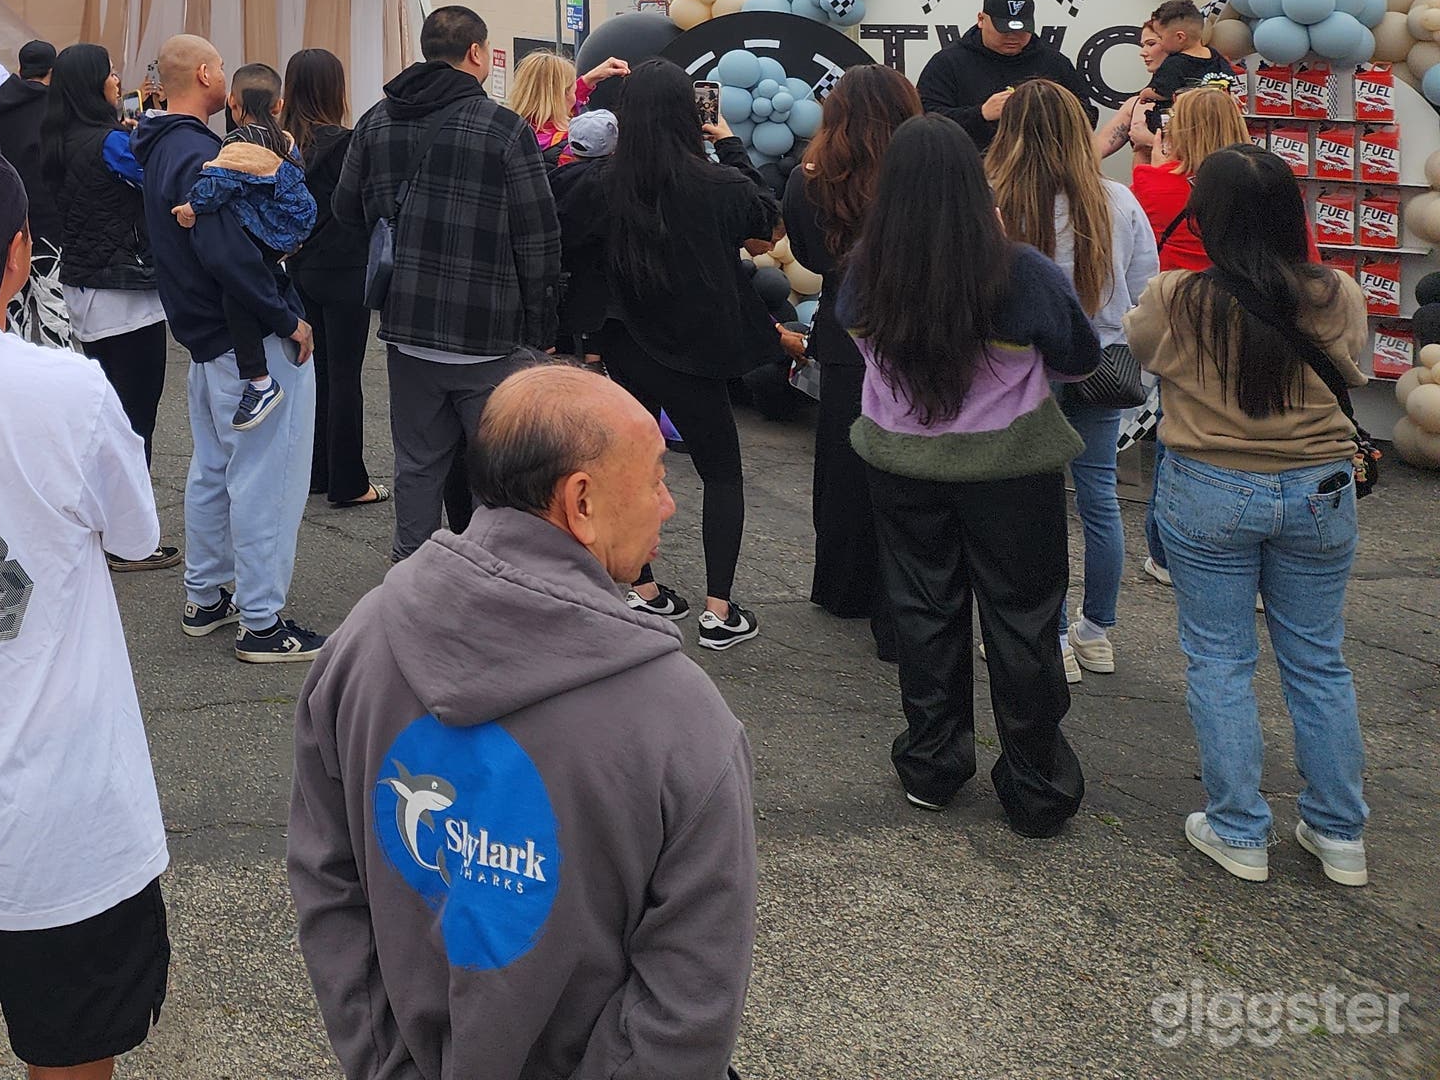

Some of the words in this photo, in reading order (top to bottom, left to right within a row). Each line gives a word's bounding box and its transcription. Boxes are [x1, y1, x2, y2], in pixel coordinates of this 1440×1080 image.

[860, 24, 1148, 110] TO
[1258, 76, 1288, 94] FUEL
[1295, 80, 1324, 98] FUEL
[1359, 81, 1391, 98] FUEL
[1274, 136, 1306, 154] FUEL
[1319, 140, 1351, 158] FUEL
[1363, 143, 1396, 161] FUEL
[1319, 204, 1350, 222] FUEL
[1363, 207, 1395, 225] FUEL
[1364, 274, 1396, 293] FUEL
[1378, 335, 1410, 353] FUEL
